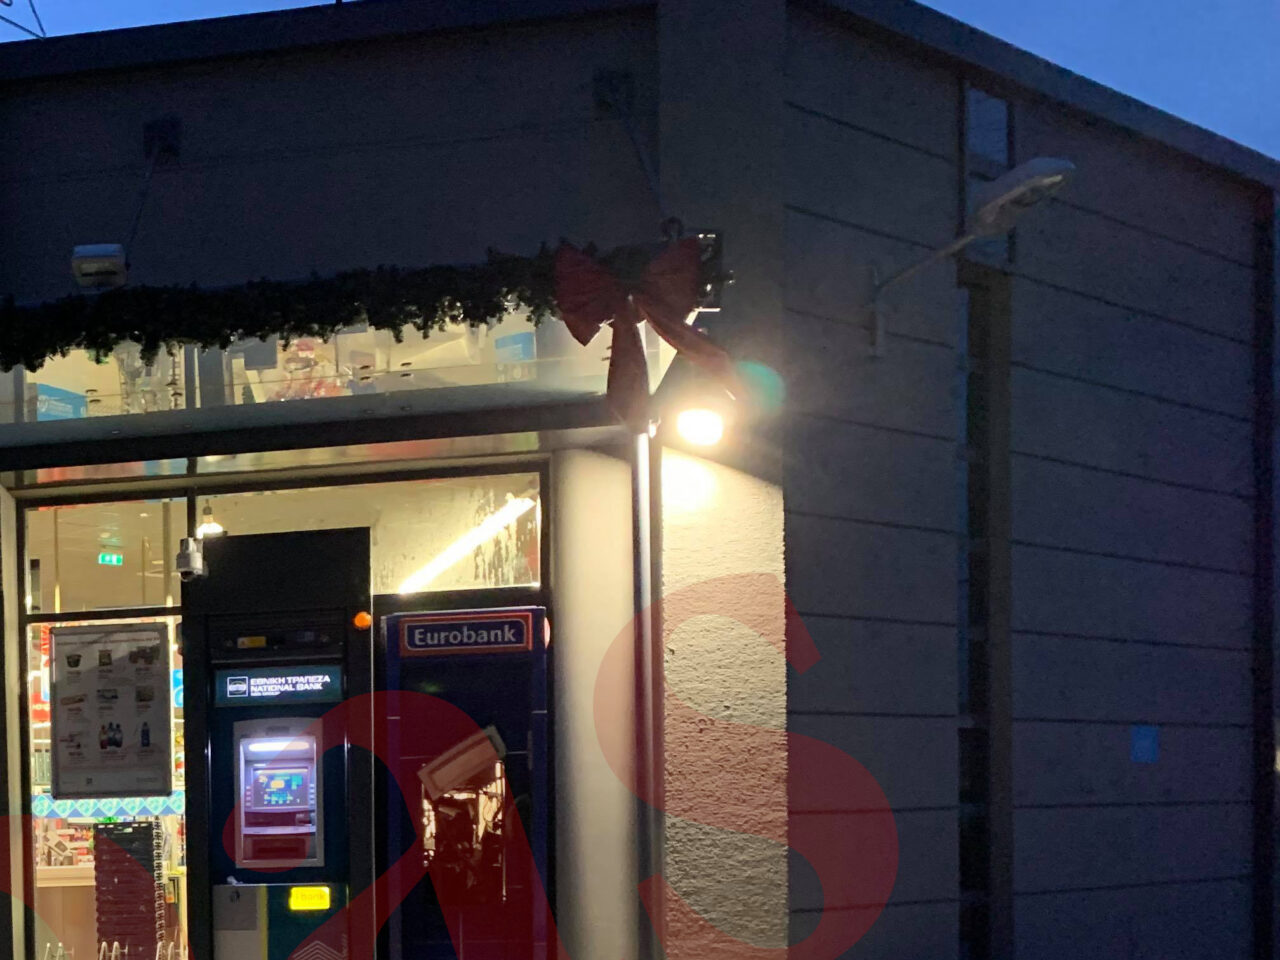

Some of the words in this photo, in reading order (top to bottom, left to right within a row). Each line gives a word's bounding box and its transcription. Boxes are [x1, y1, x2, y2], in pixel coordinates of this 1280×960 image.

[413, 624, 517, 646] Eurobank
[250, 684, 296, 693] NATIONAL
[297, 682, 323, 691] BANK
